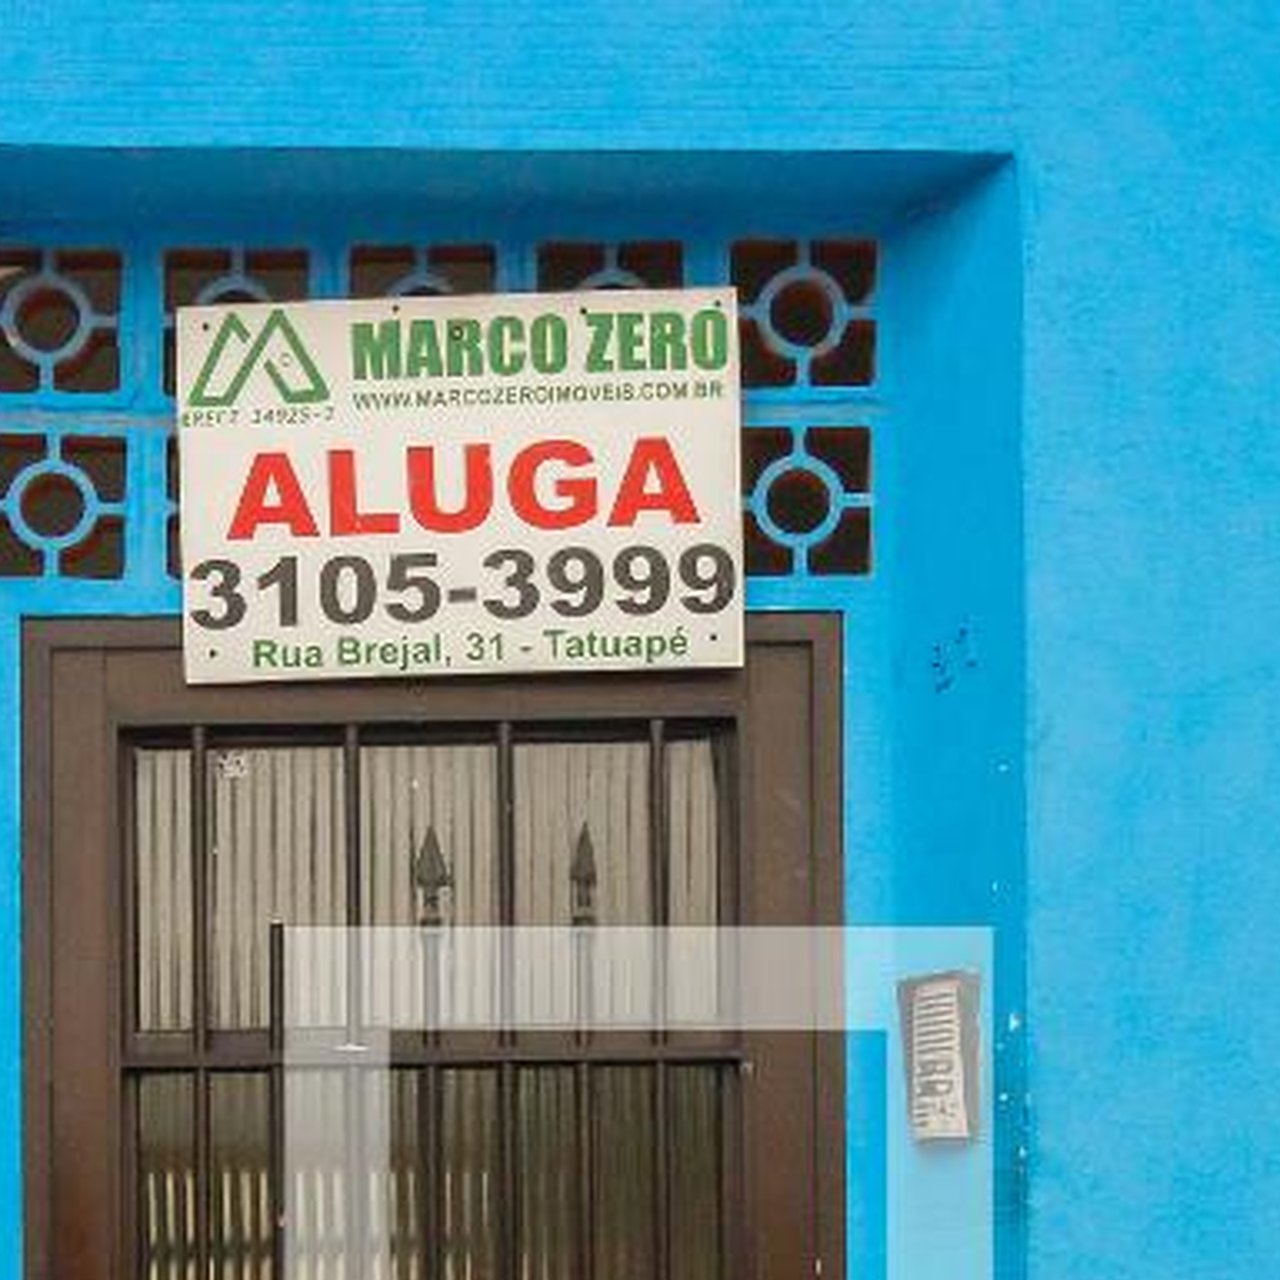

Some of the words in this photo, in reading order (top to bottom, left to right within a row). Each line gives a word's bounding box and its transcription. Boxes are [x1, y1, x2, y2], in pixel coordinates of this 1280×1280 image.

[351, 313, 568, 380] MARCO
[584, 308, 728, 373] ZERO
[226, 436, 701, 541] ALUGA
[189, 543, 736, 630] 3105-3999
[252, 638, 321, 668] Rua
[337, 634, 453, 670] Brejal,
[465, 633, 505, 661] 31
[543, 626, 688, 664] Tatuapé
